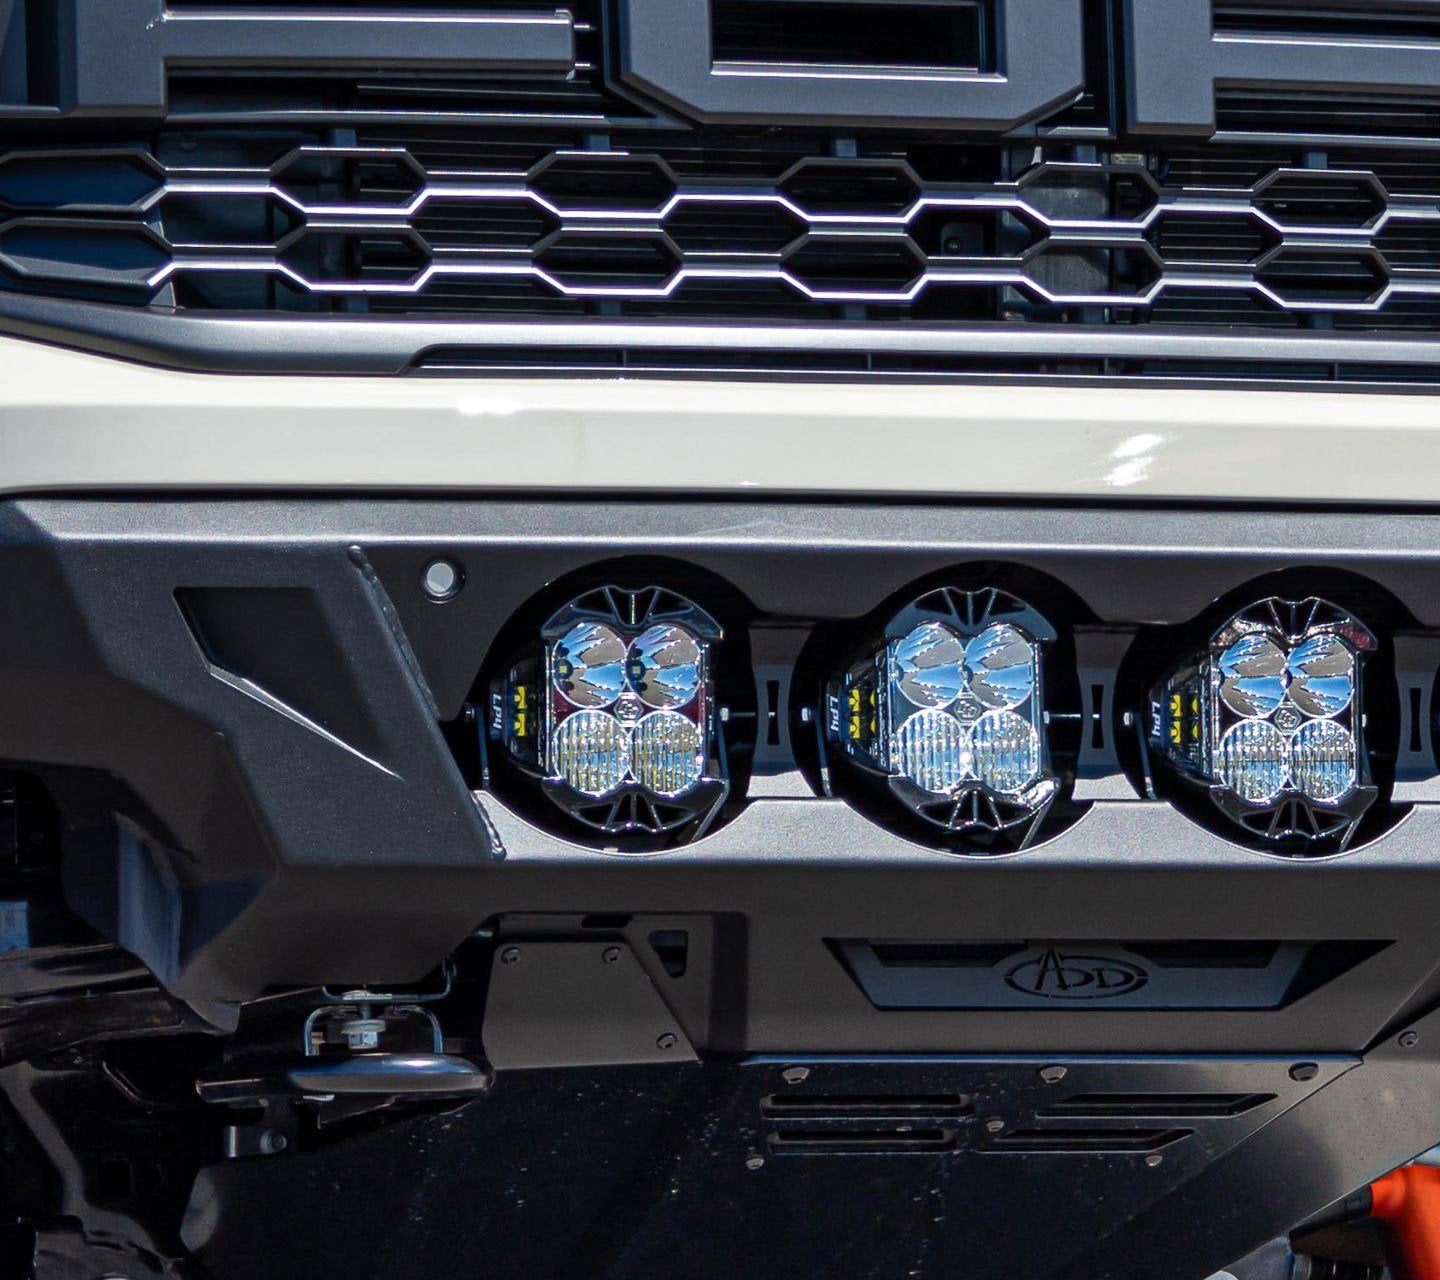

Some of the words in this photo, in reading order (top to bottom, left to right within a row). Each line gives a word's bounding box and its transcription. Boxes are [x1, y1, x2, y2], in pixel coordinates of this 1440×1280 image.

[492, 693, 503, 730] LP4
[829, 695, 840, 732] LP4
[1151, 700, 1161, 737] LP4
